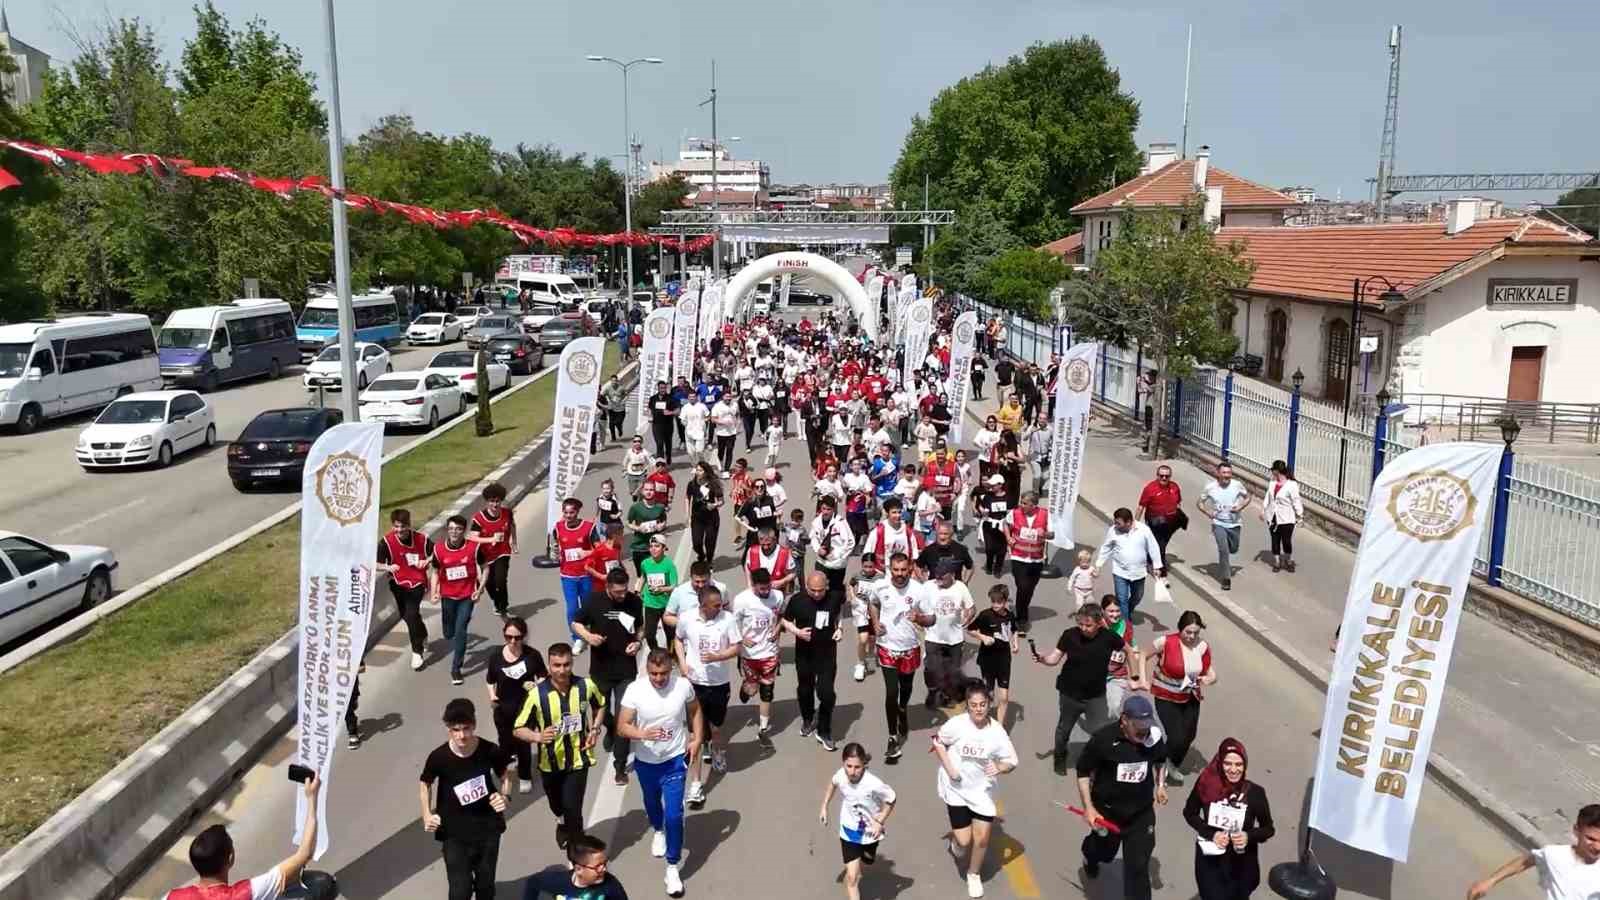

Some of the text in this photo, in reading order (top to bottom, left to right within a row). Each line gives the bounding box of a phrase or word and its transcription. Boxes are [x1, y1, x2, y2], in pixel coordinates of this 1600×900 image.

[1494, 286, 1567, 302] KIRIKKALE
[555, 406, 575, 503] KIRIKKALE
[348, 567, 361, 615] Ahmet
[301, 709, 311, 761] MAYIS
[308, 576, 321, 623] ANMA
[318, 653, 331, 696] SPOR
[336, 619, 353, 688] OLSUN
[1336, 581, 1407, 779] KIRIKKALE
[318, 699, 329, 718] VE
[1374, 578, 1453, 800] BELEDİYESİ
[461, 785, 486, 804] 002
